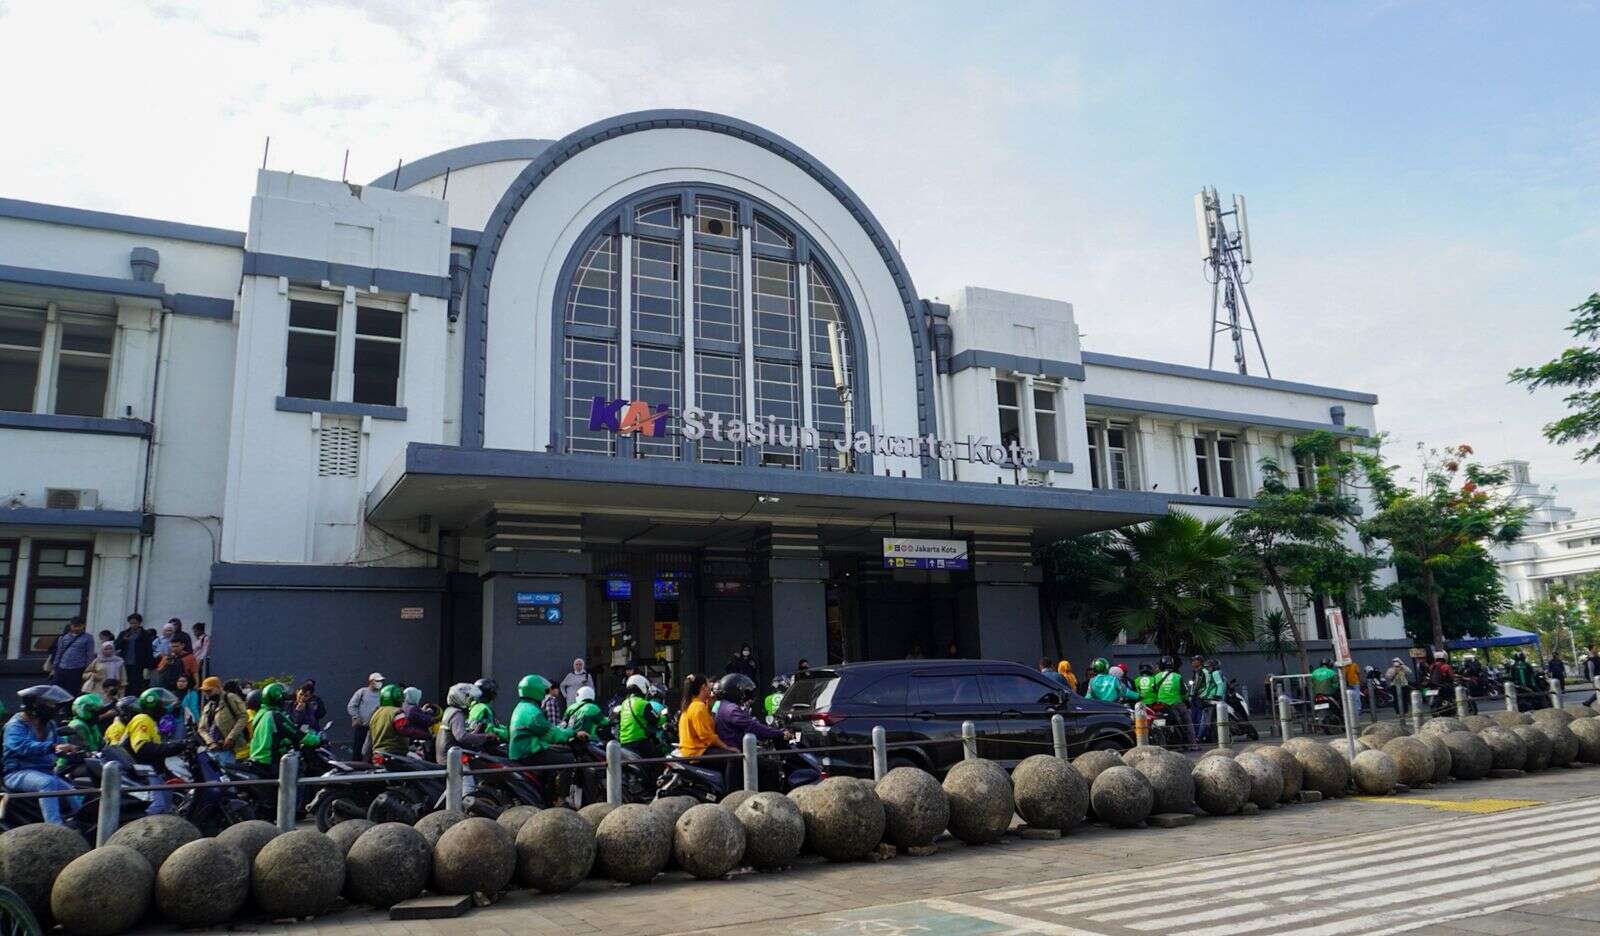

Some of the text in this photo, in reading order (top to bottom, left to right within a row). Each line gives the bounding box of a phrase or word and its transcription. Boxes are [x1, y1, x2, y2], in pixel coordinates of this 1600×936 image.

[589, 396, 1038, 467] KAI Stasiun Jakarta Kota
[915, 544, 940, 553] Jakarta
[942, 545, 956, 553] Kota
